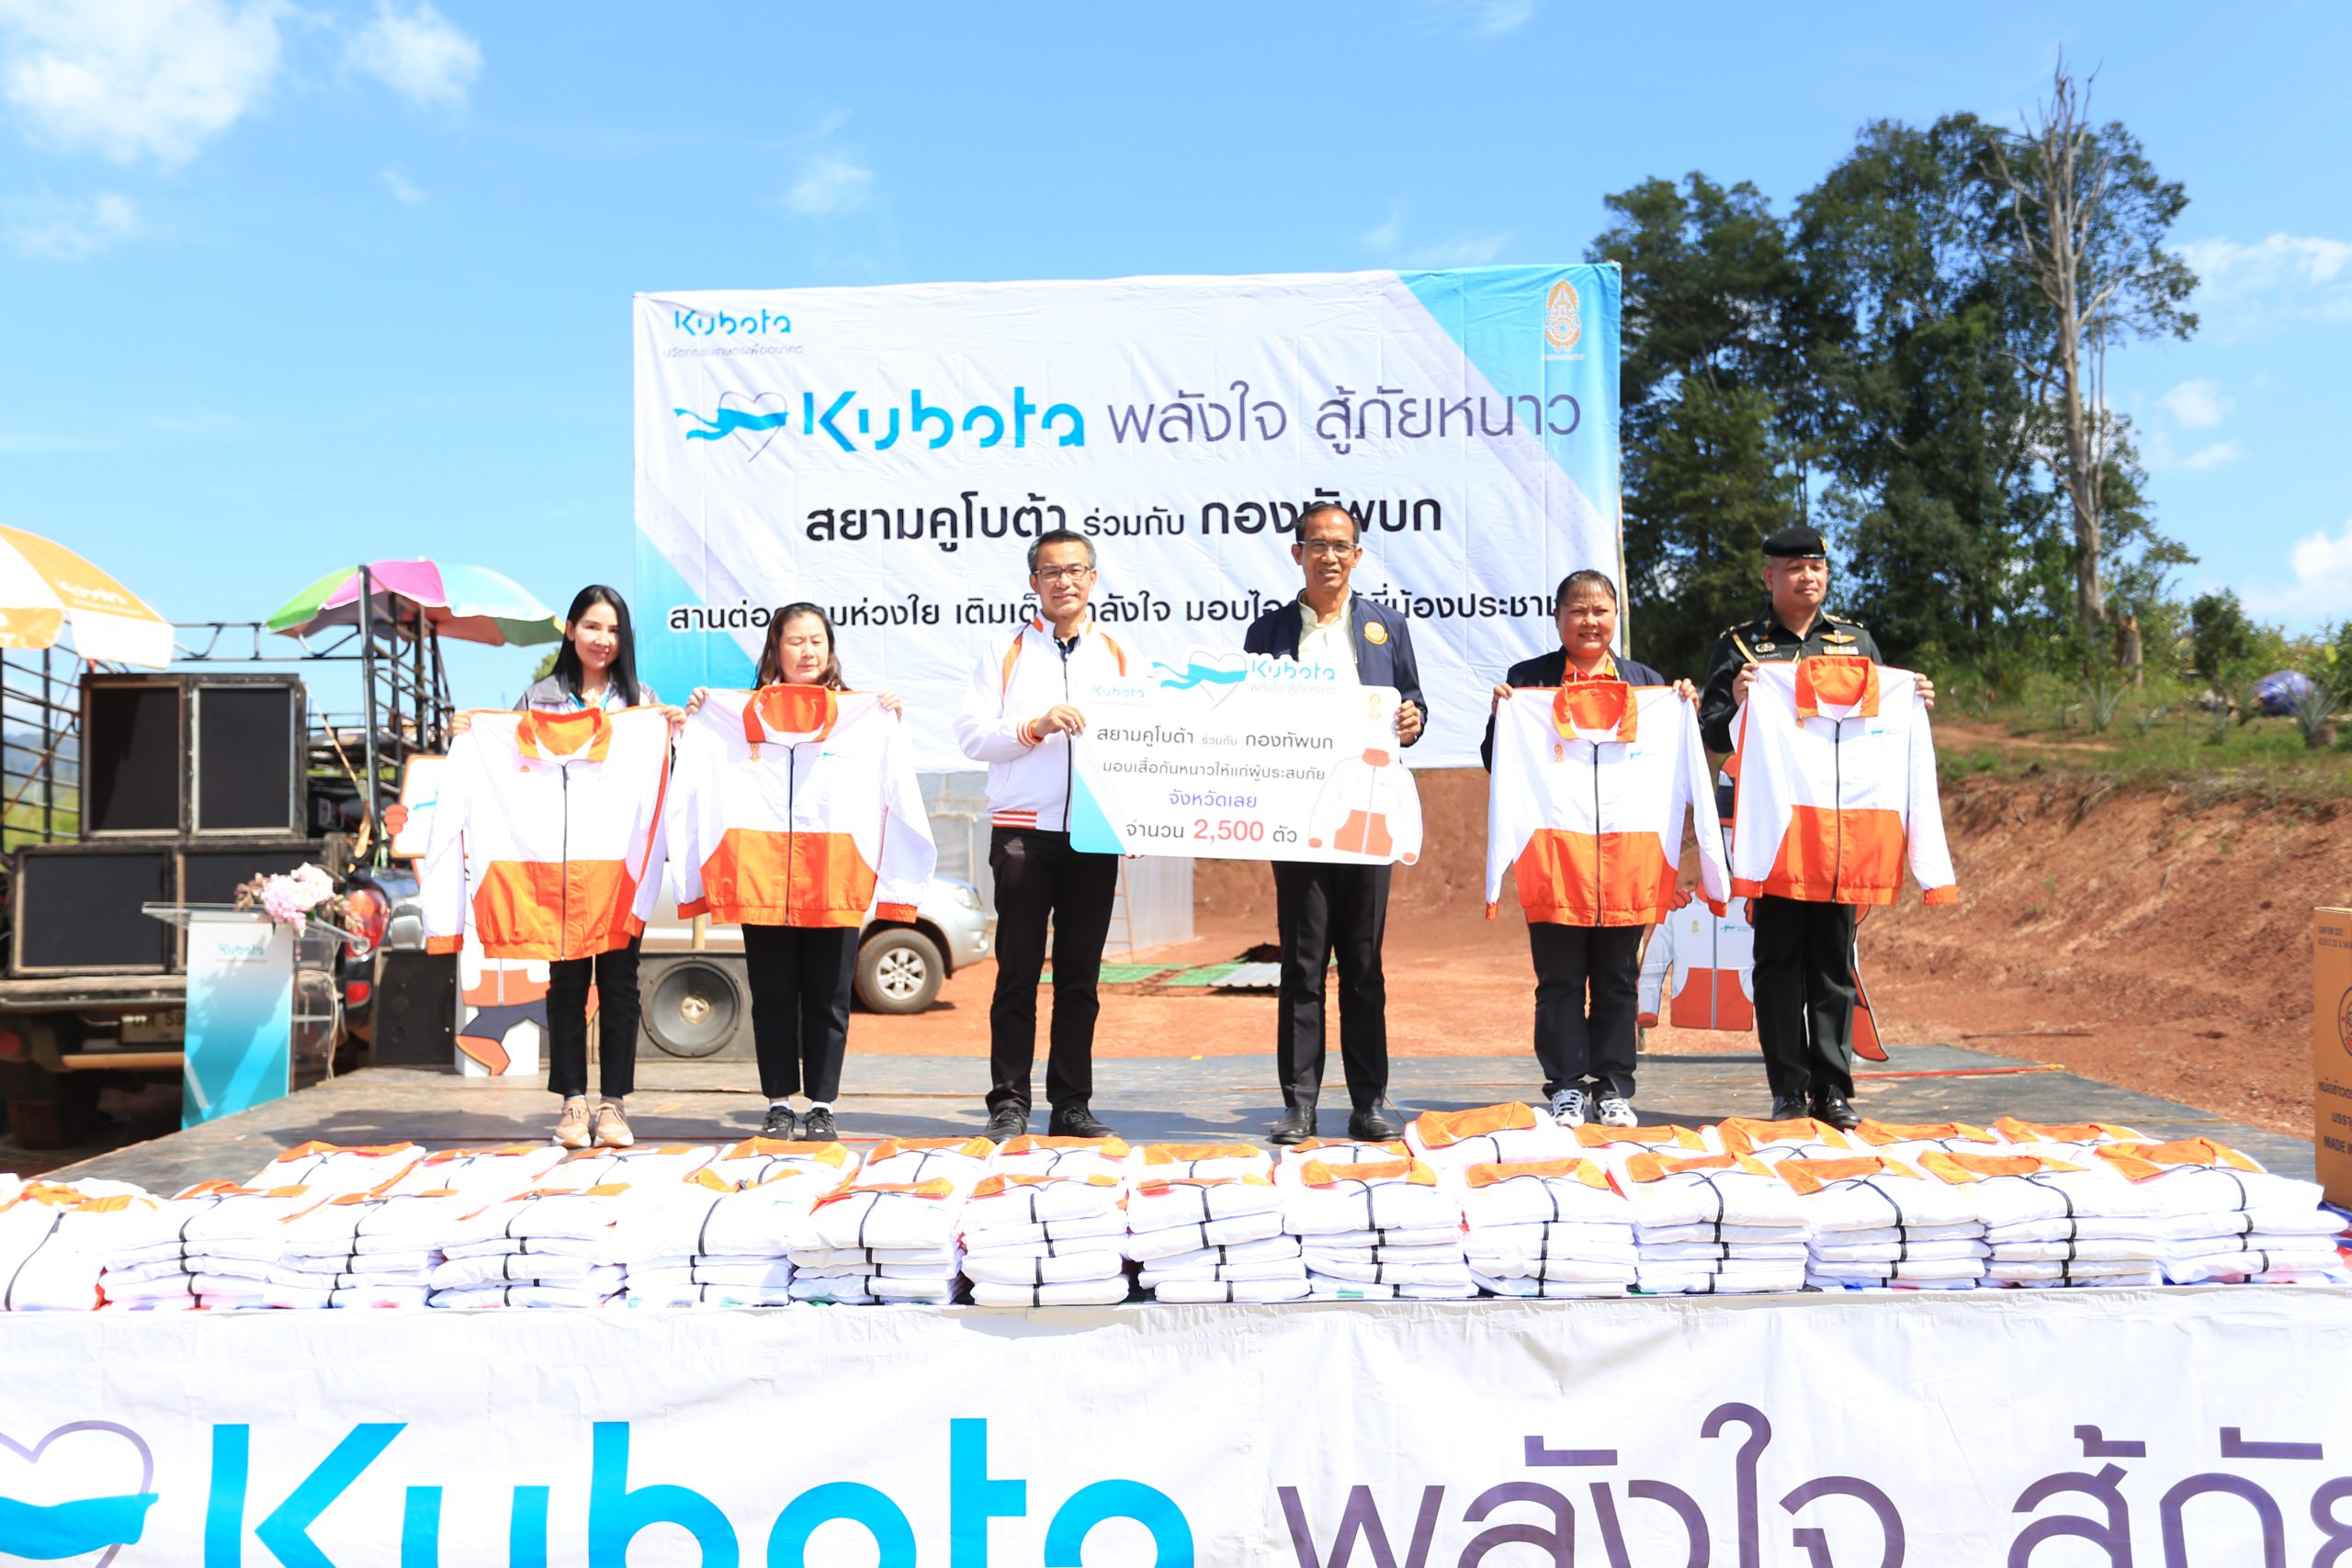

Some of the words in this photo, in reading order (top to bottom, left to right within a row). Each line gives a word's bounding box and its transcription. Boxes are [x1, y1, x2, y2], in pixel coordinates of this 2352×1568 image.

[675, 309, 791, 336] Kubota
[803, 386, 1085, 452] Kubota
[1107, 380, 1288, 444] พลังใจ
[1316, 385, 1581, 456] สู้ภัยหนาว
[806, 491, 1066, 553] สยามคูโบต้า
[1083, 506, 1185, 536] ร่วมกับ
[1251, 660, 1336, 681] Kubota
[1092, 684, 1145, 698] Kubota
[1097, 726, 1193, 748] สยามคูโบต้า
[1202, 734, 1238, 747] ร่วมกับ
[1246, 731, 1333, 750] กองทัพบก
[1169, 789, 1257, 808] จังหวัดเลย
[1125, 819, 1184, 839] จำนวน
[1193, 818, 1264, 843] 2,500
[1272, 825, 1298, 843] ตัว
